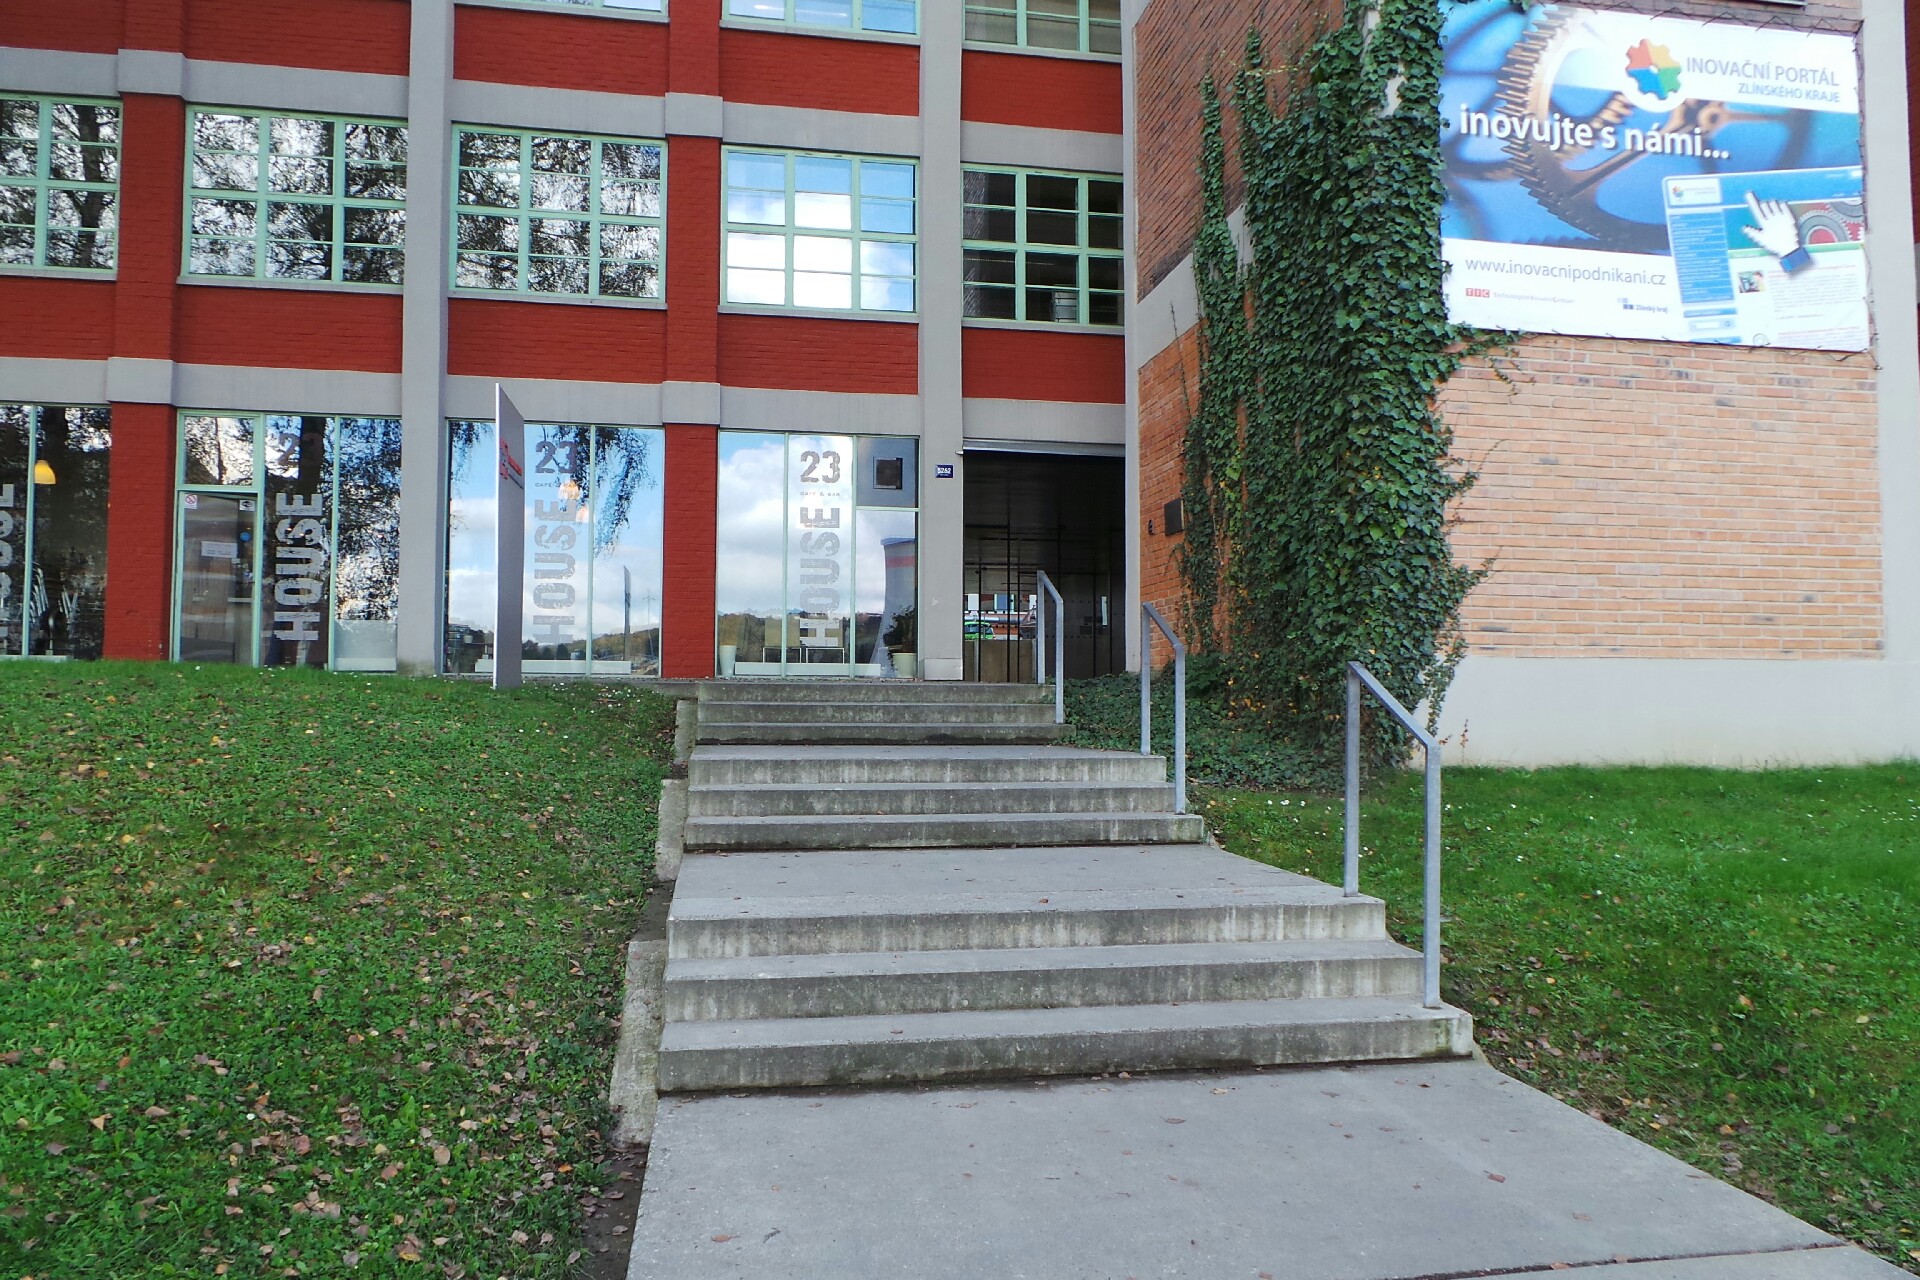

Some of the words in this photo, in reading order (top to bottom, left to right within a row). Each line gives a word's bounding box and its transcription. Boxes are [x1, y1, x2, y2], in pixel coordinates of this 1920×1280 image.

[1686, 57, 1771, 80] INOVAČNÍ
[1775, 66, 1840, 87] PORTÁL
[1738, 82, 1803, 99] ZLÍNSKÉHO
[1805, 89, 1840, 103] KRAJE
[1460, 103, 1594, 151] inovujte
[1602, 126, 1616, 149] s
[1625, 124, 1730, 159] námi...
[1465, 258, 1666, 286] www.inovacnipodnikani.cz
[535, 441, 577, 474] 23
[800, 451, 841, 484] 23
[273, 492, 324, 642] HOUSE
[533, 499, 576, 644] HOUSE
[800, 507, 840, 647] HOUSE
